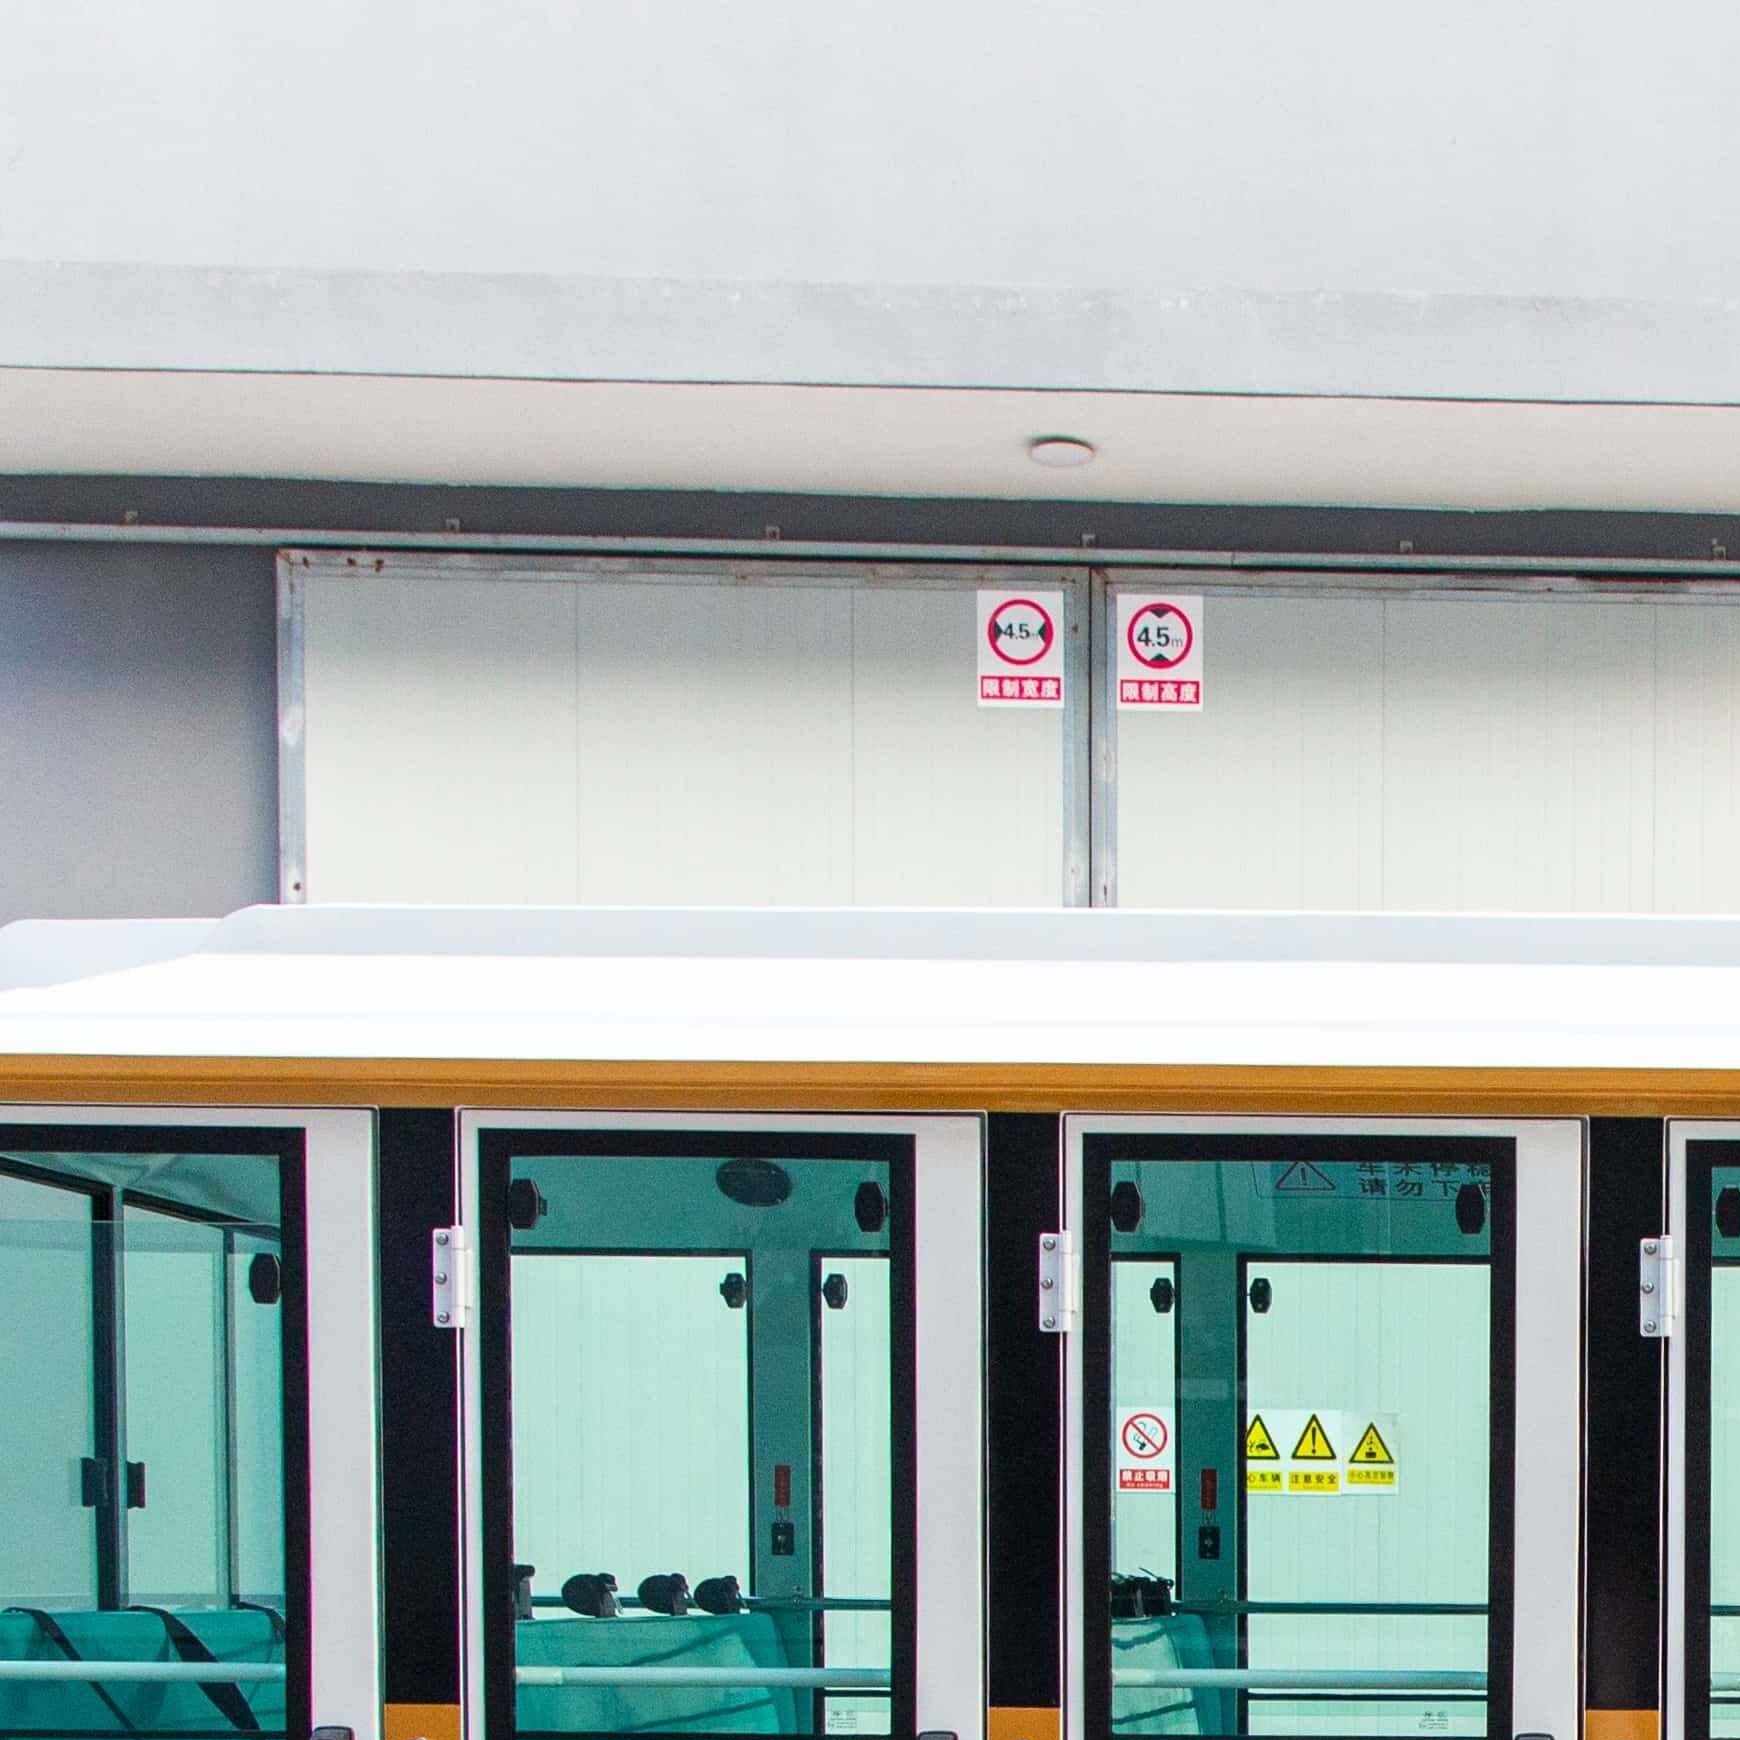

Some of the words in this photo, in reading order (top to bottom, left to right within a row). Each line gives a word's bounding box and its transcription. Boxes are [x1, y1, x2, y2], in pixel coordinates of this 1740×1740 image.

[1137, 626, 1184, 648] 4.5m
[982, 678, 1060, 699] 限制宽度
[1121, 682, 1199, 703] 限制高度
[1291, 1473, 1337, 1484] 注意安全
